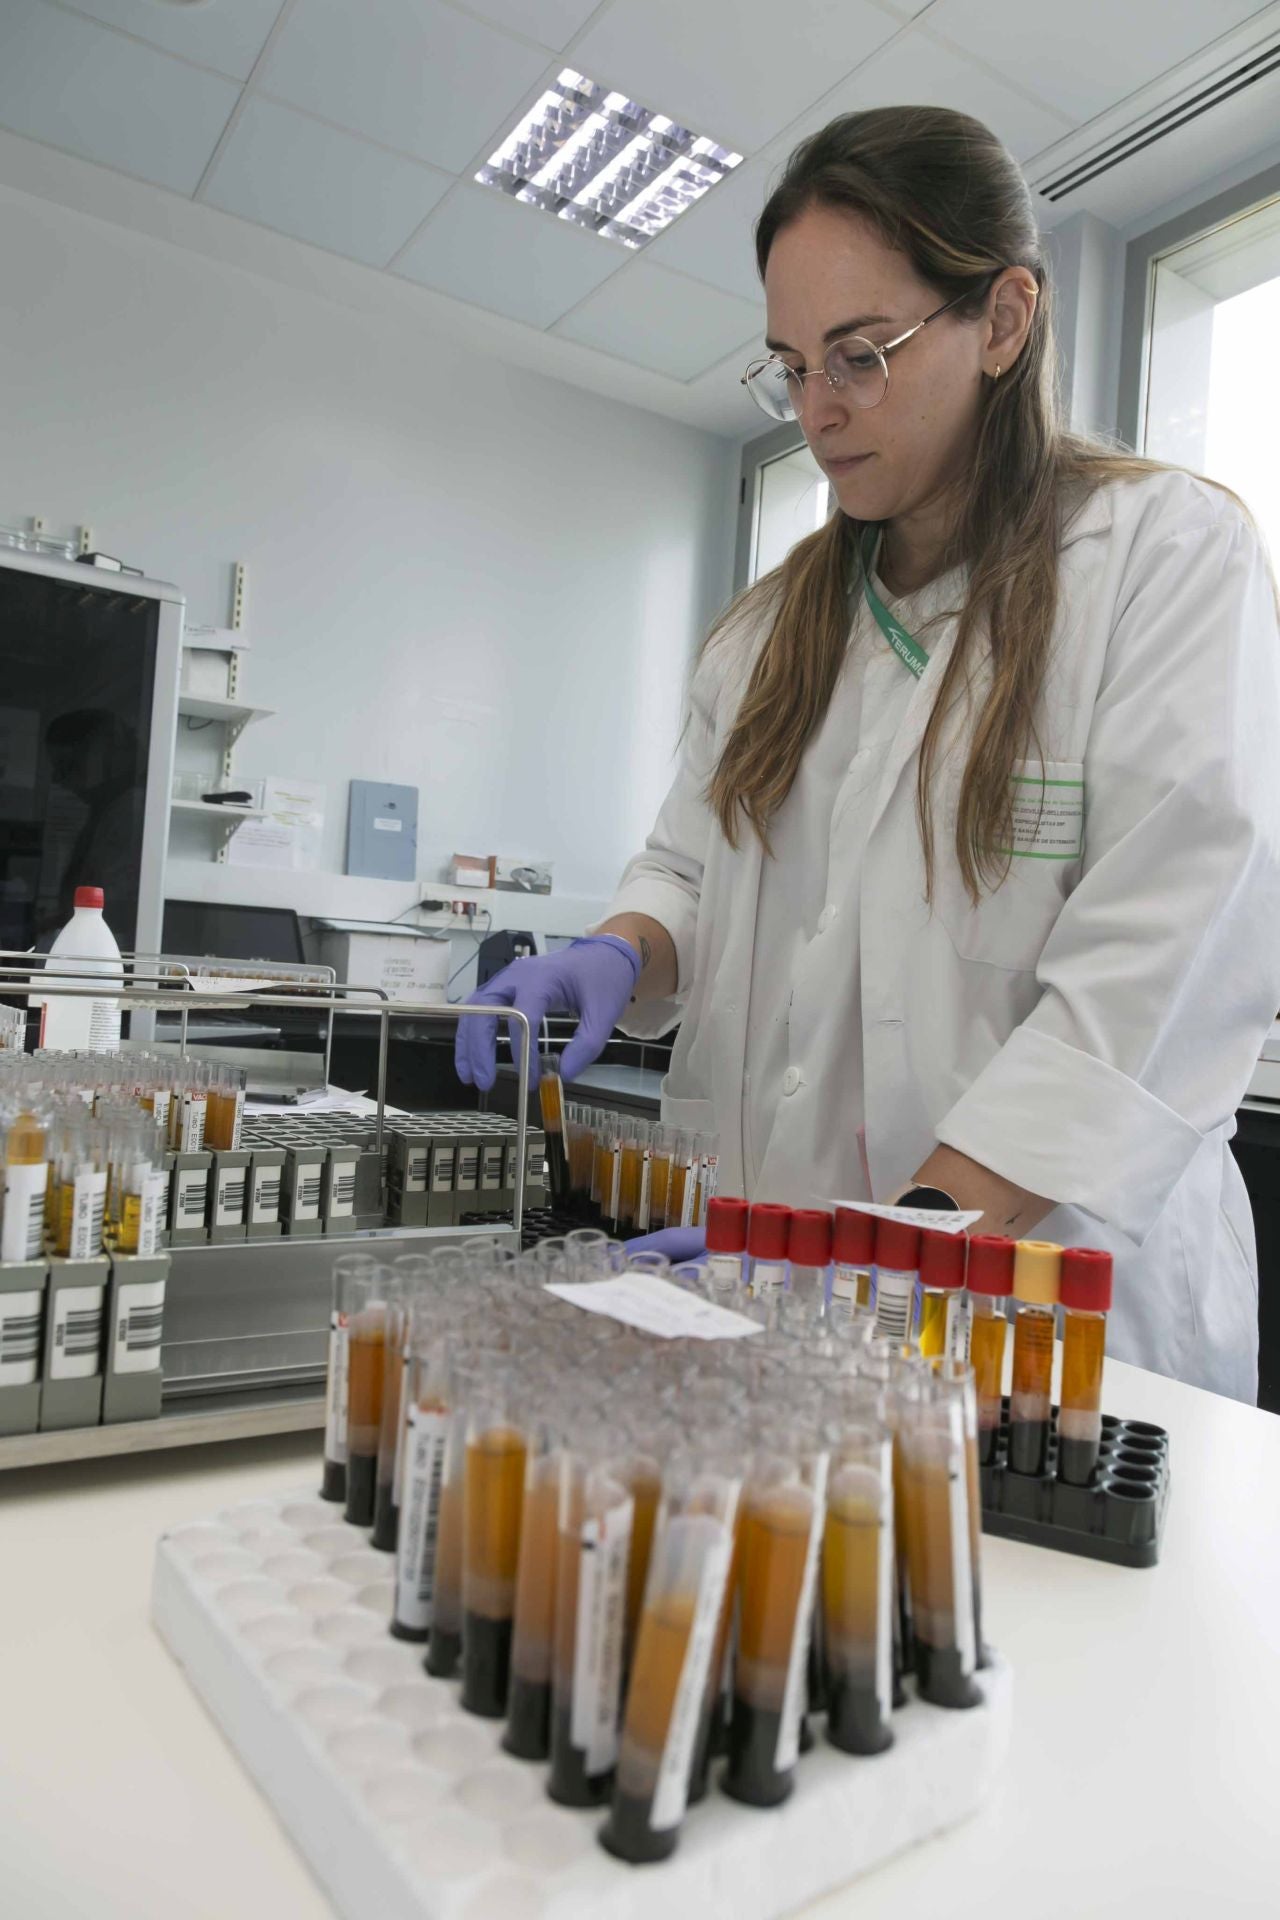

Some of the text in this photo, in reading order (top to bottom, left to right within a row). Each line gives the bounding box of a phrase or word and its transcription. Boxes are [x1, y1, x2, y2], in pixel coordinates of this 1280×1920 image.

[191, 1111, 199, 1129] TUBO
[78, 1193, 89, 1219] TUBO
[143, 1196, 153, 1223] TUBO
